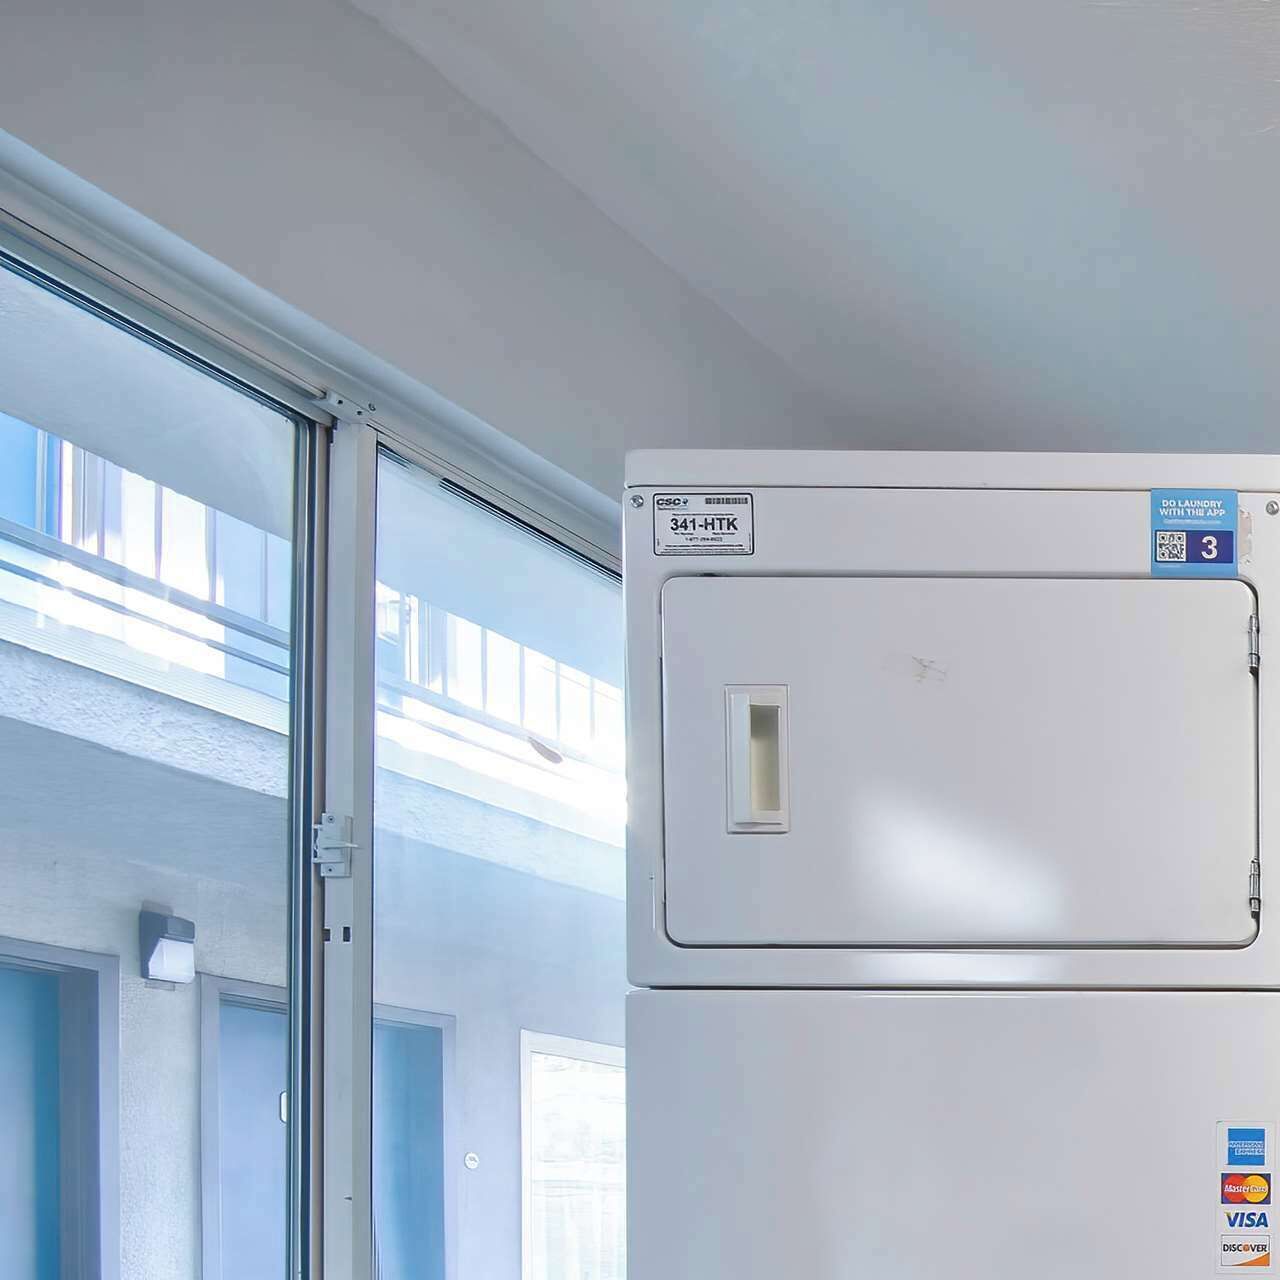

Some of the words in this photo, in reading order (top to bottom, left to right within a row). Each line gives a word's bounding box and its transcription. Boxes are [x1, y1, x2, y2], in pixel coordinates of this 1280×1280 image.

[670, 518, 738, 531] 341-HTK
[1201, 536, 1217, 559] 3
[1225, 1212, 1268, 1227] VISA
[1223, 1244, 1267, 1252] DISCOVER
